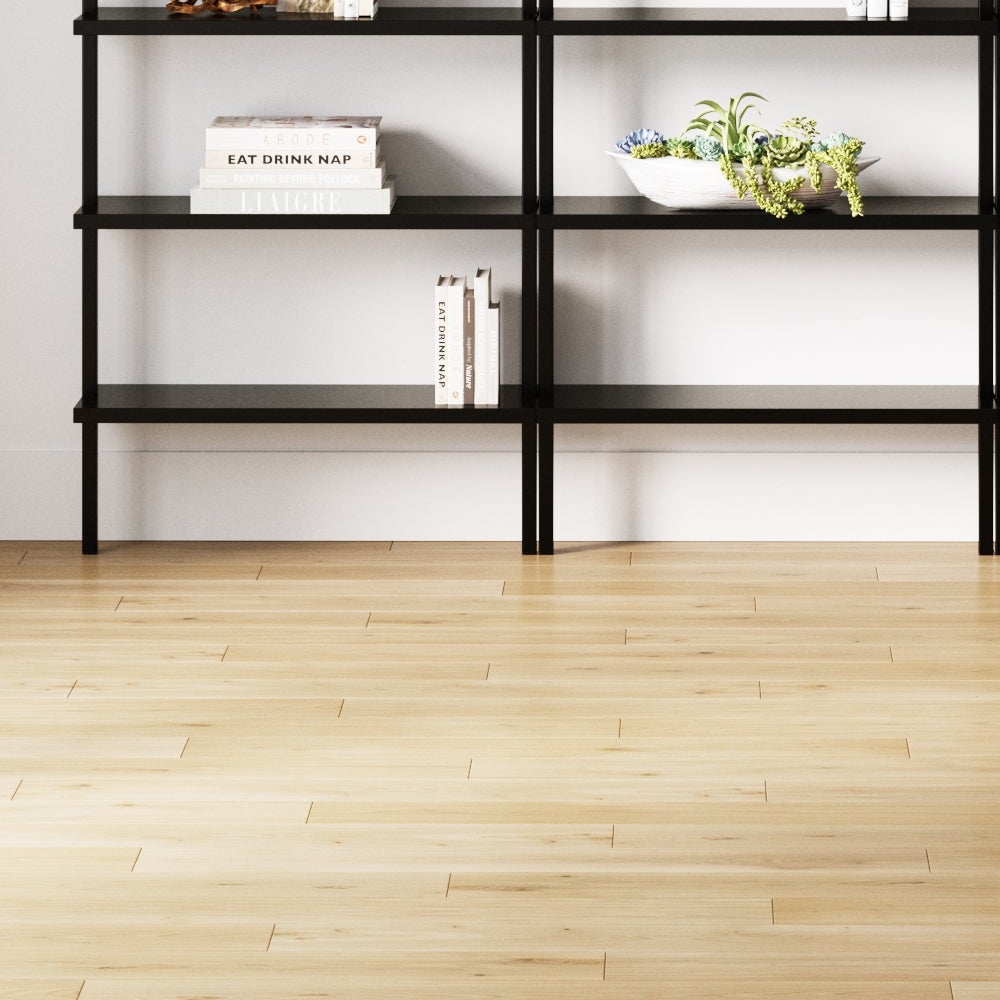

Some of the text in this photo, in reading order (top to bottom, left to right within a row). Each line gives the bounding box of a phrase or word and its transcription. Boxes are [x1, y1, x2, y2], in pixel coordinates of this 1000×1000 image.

[263, 133, 331, 145] ABODE
[228, 154, 351, 165] EAT DRINK NAP
[438, 301, 446, 388] EAT DRINK NAP
[465, 364, 473, 389] Nature
